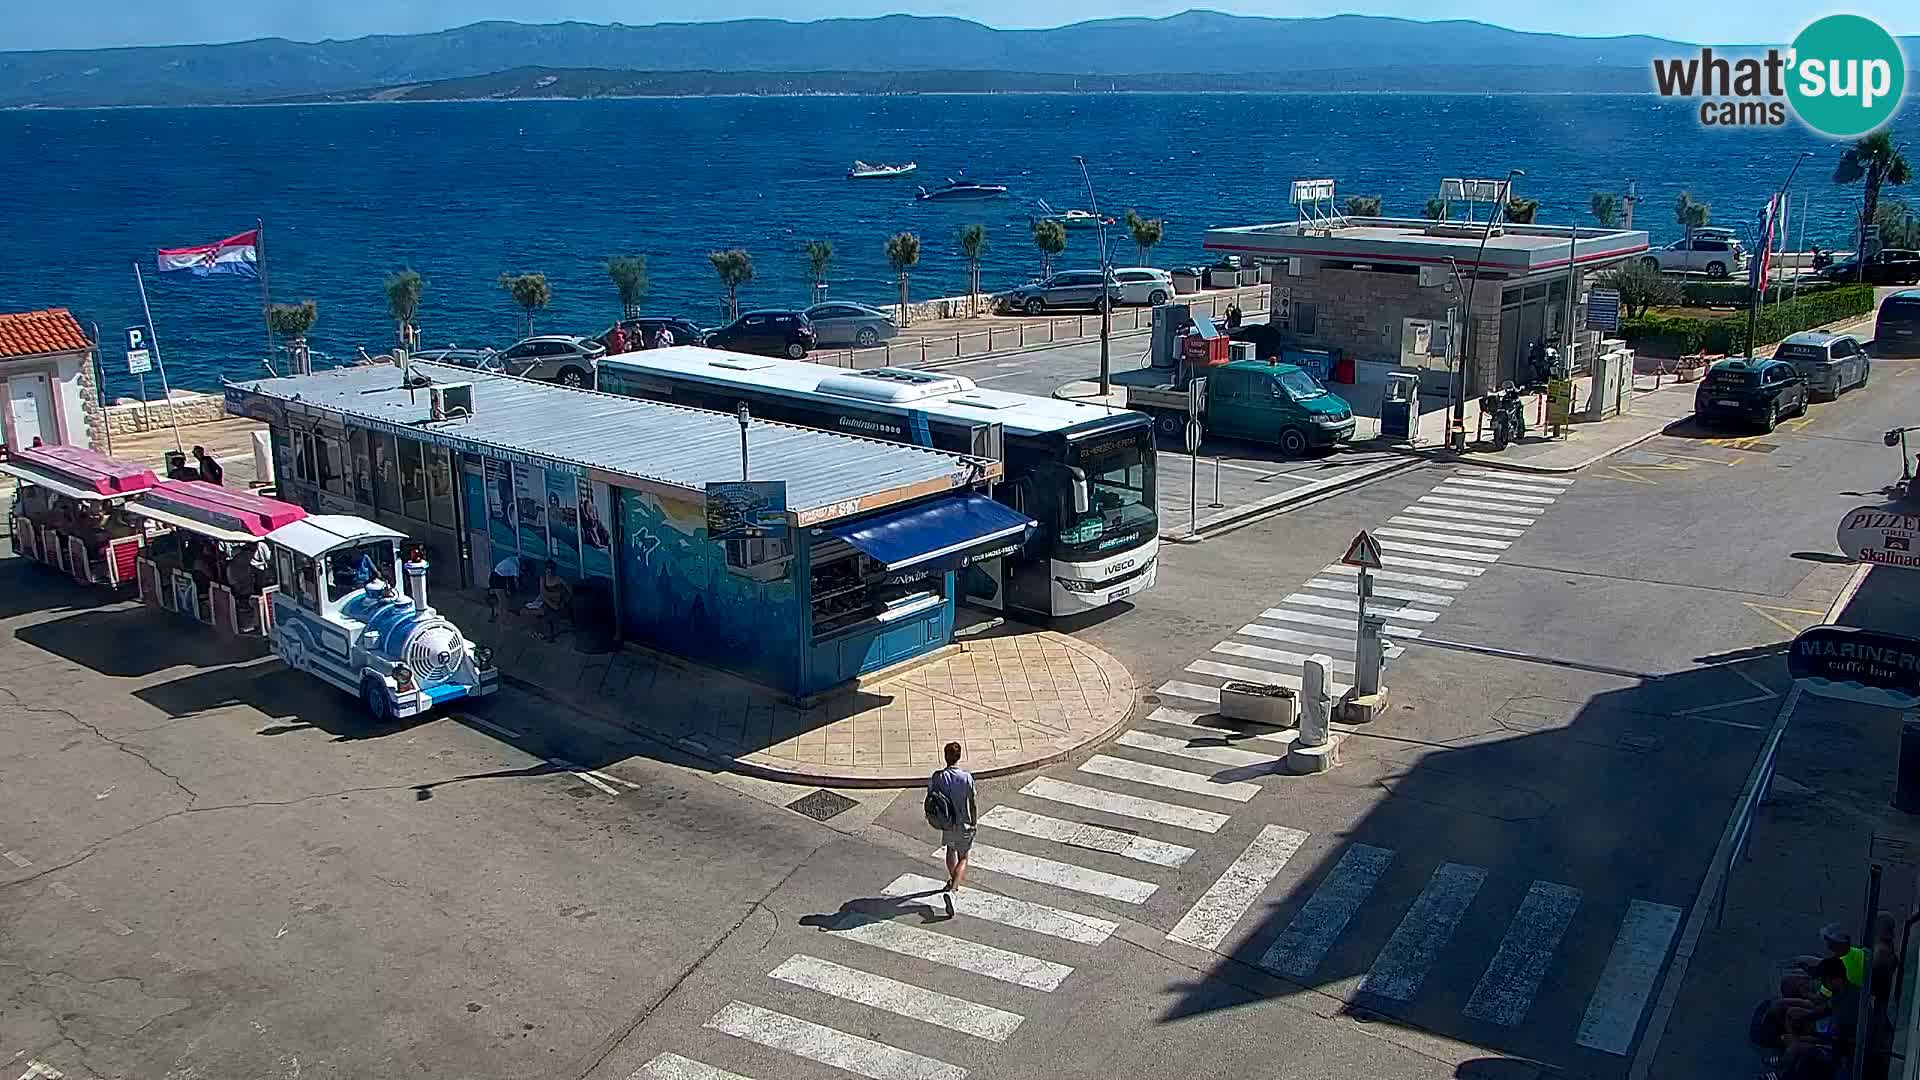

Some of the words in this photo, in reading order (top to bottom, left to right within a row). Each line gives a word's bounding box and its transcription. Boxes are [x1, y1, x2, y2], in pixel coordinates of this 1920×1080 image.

[129, 330, 141, 348] P
[1793, 346, 1811, 354] TAXI
[477, 444, 492, 456] BUS
[492, 447, 526, 464] STATION
[527, 456, 553, 470] TICKET
[555, 460, 582, 476] OFFICE
[1104, 559, 1135, 576] IVECO
